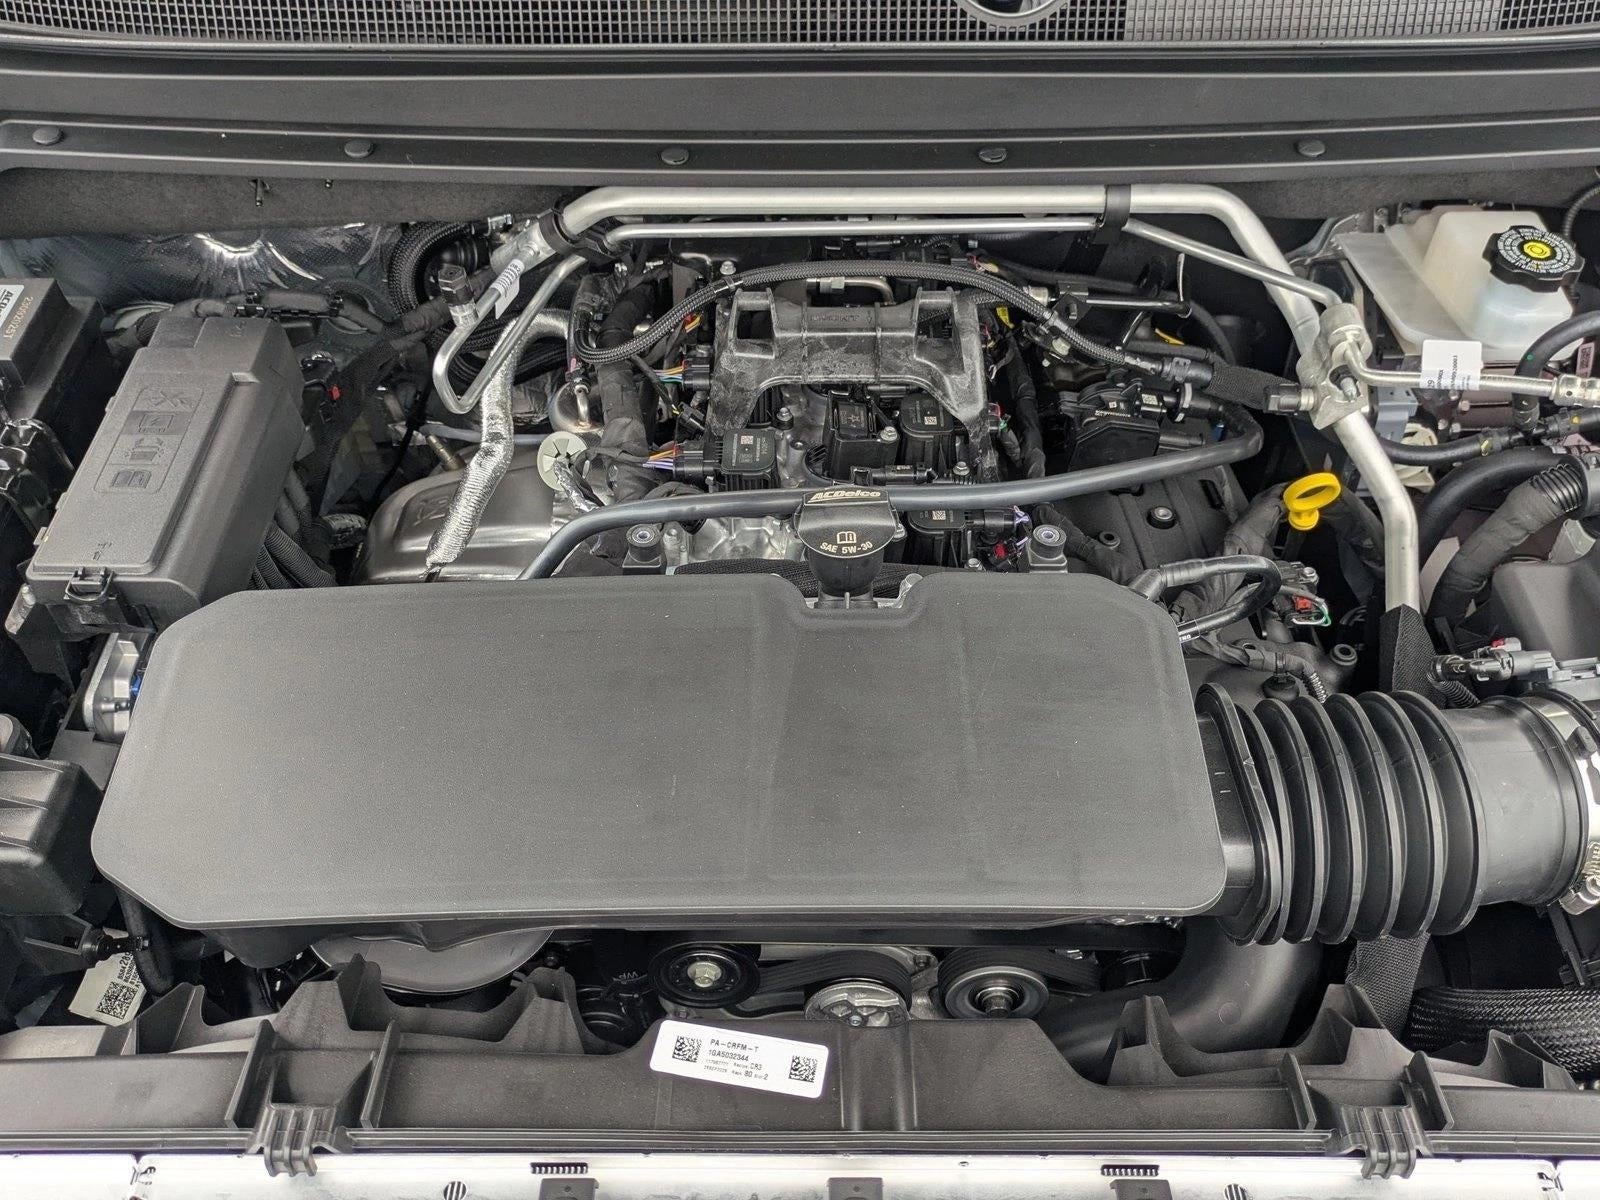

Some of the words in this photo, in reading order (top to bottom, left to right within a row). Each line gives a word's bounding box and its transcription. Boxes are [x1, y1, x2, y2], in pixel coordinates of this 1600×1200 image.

[808, 489, 881, 502] ACDelco
[820, 542, 838, 554] SAE
[841, 541, 873, 554] 5W-30
[710, 1038, 759, 1053] PA-CRFM-T
